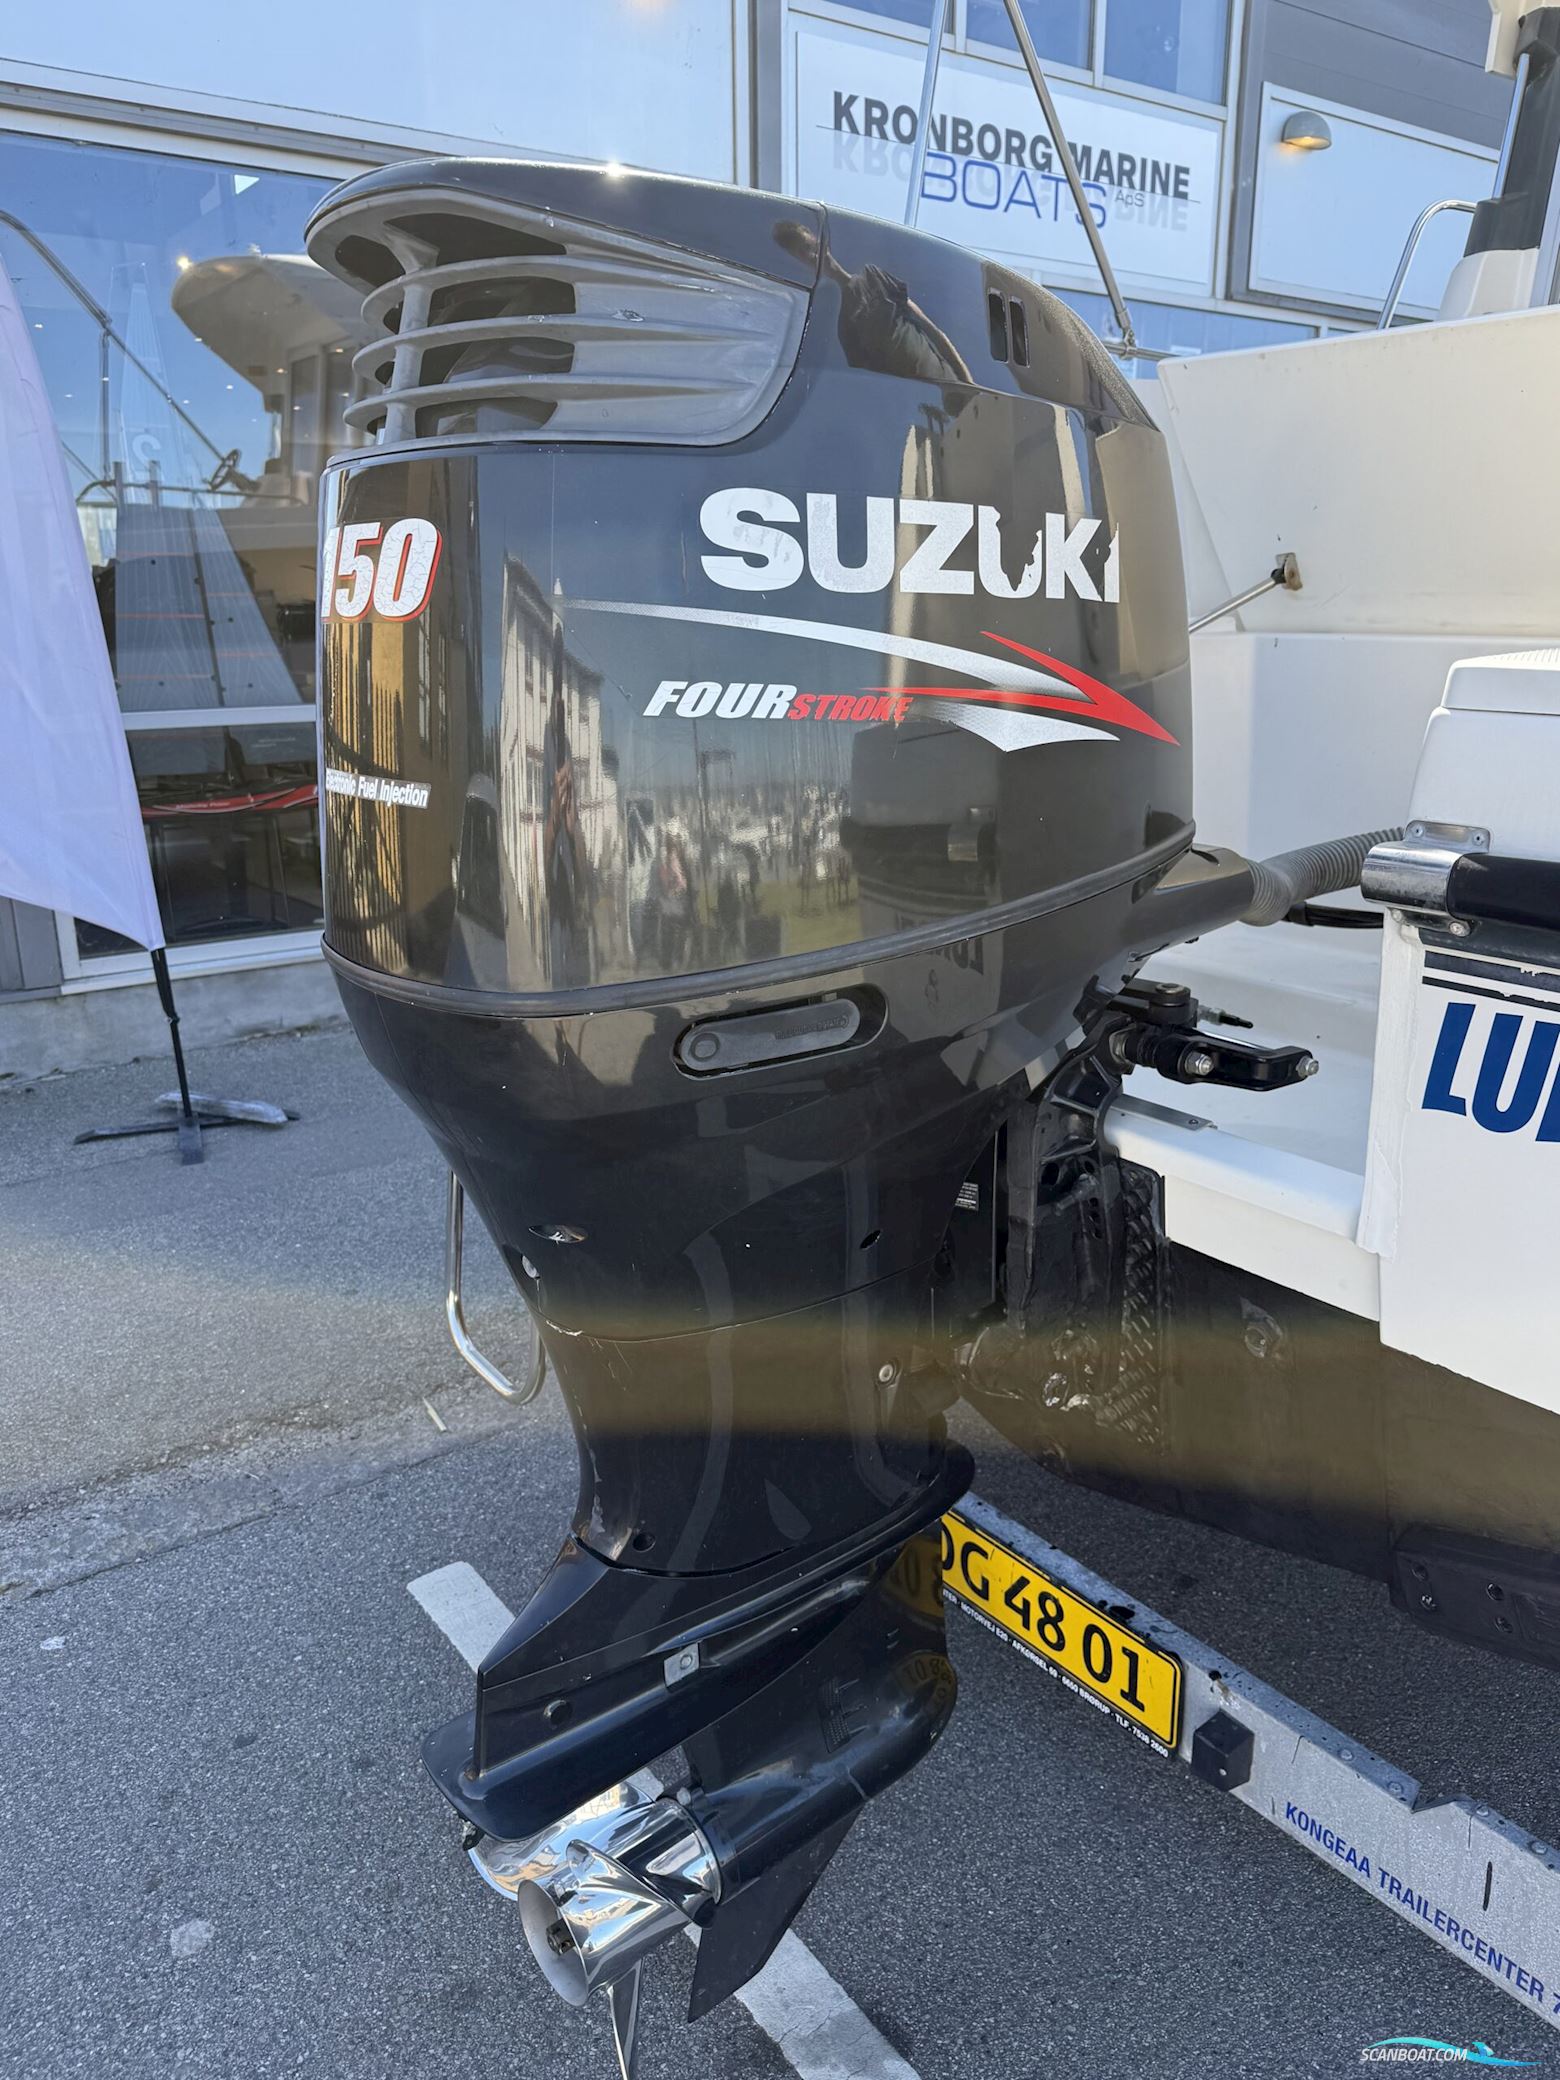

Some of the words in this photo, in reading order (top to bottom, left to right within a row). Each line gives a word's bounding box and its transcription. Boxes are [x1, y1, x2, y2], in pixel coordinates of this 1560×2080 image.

[834, 91, 1052, 173] KRONBORG
[1067, 141, 1190, 200] MARINE
[921, 152, 1106, 229] BOATS
[1115, 189, 1145, 207] ApS
[321, 518, 443, 622] 150
[700, 487, 1119, 603] SUZUKI
[358, 776, 378, 799] Fuel
[380, 780, 429, 807] Injection
[1004, 1575, 1066, 1652] 48
[1082, 1623, 1145, 1712] 01
[1286, 1802, 1371, 1878] KONGEAA
[1378, 1867, 1545, 2001] TRAILERCENTER
